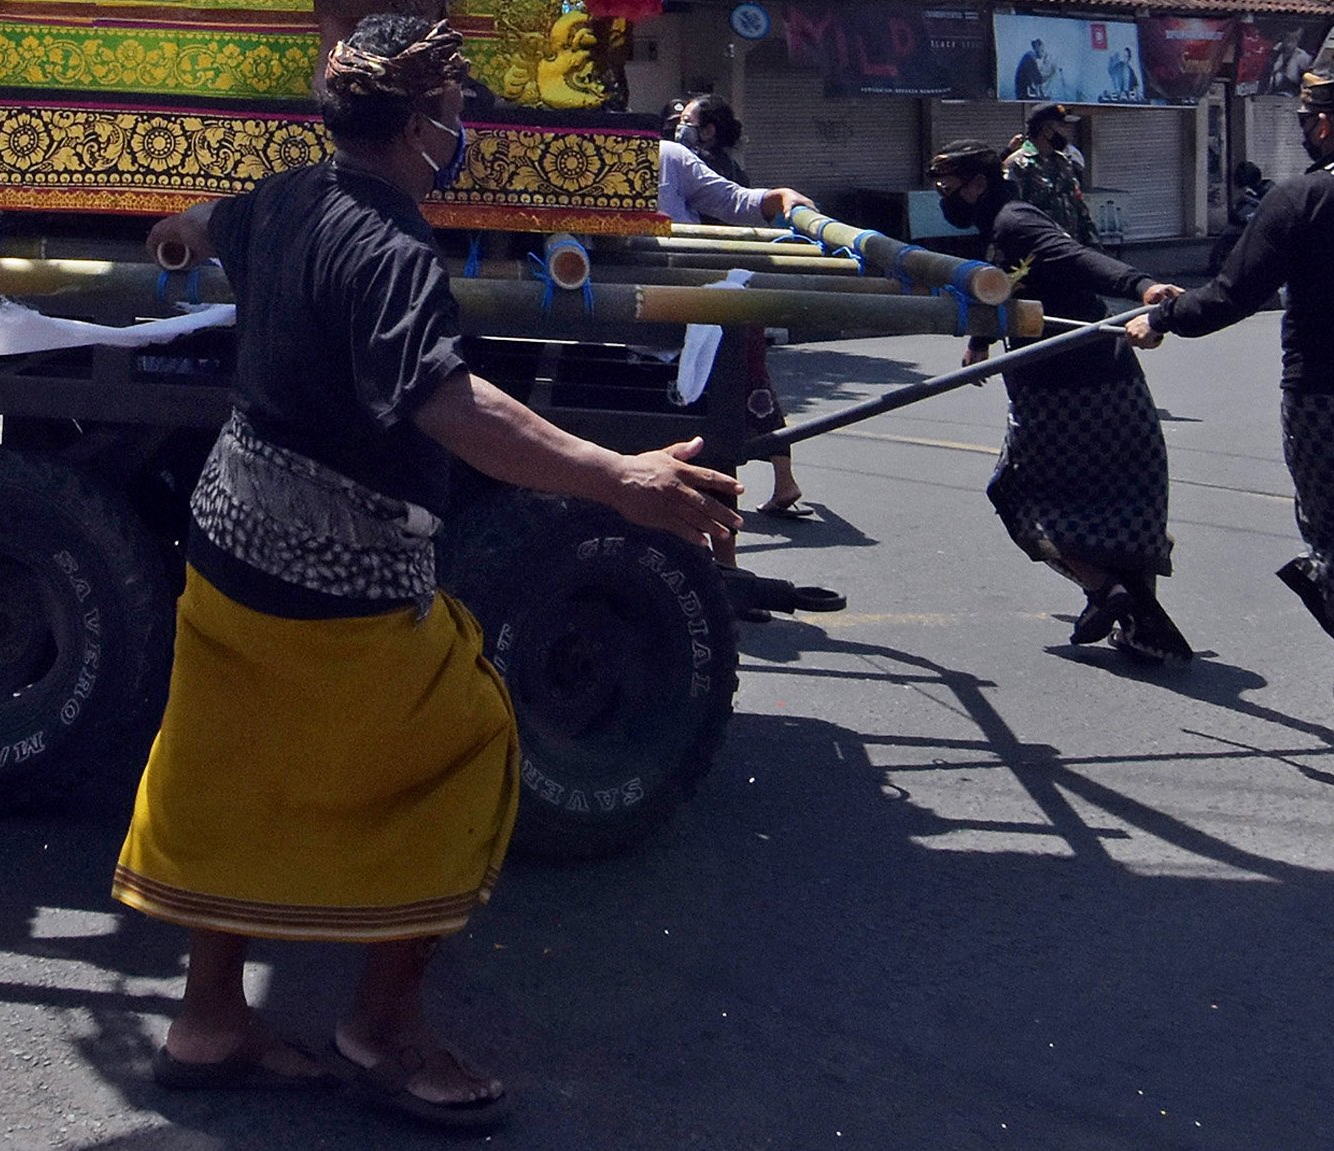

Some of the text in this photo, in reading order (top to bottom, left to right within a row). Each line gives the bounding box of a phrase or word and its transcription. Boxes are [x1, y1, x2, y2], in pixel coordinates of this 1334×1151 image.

[53, 549, 102, 726] SAVERO
[638, 546, 712, 698] RADIAL
[524, 758, 645, 813] SAVER
